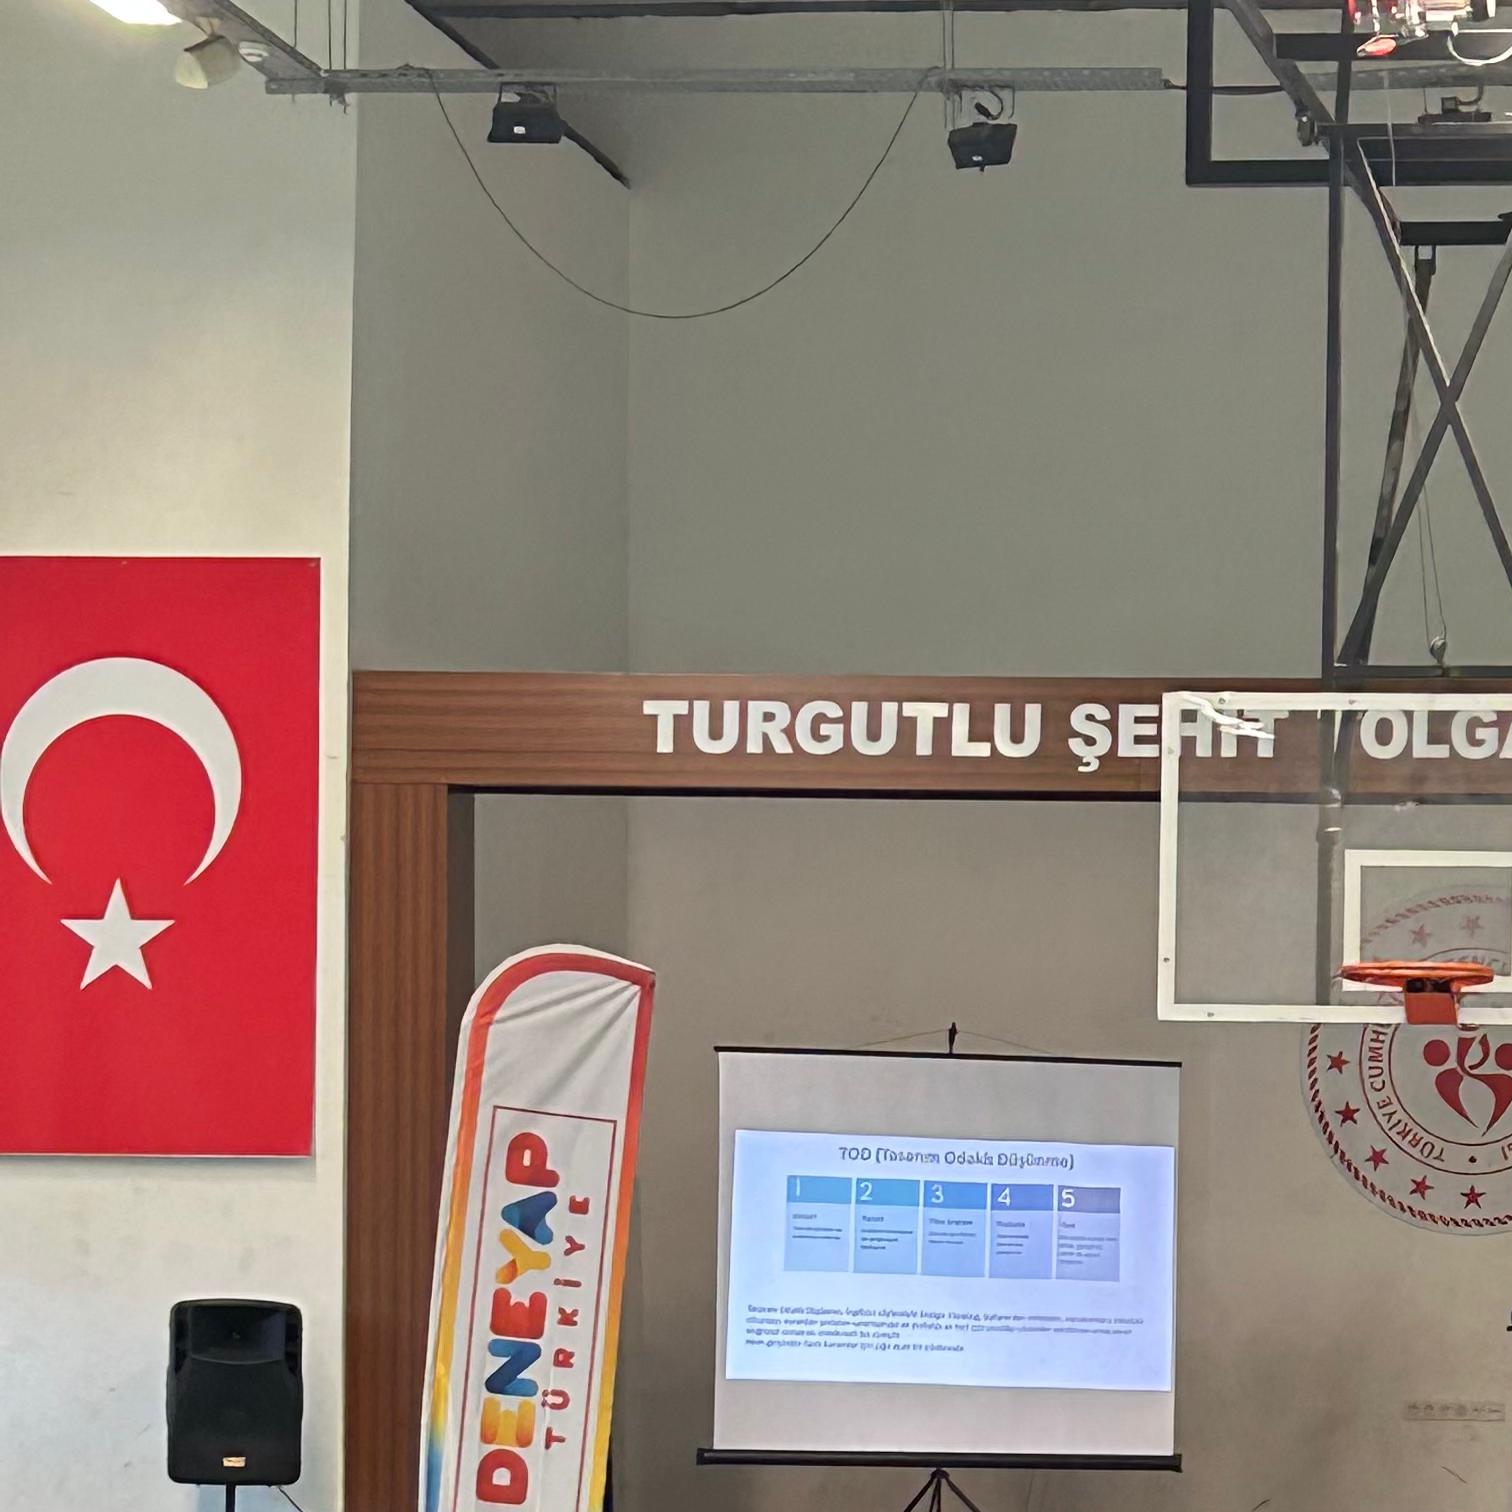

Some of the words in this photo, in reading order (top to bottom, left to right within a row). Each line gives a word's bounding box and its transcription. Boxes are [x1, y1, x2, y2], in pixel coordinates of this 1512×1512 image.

[642, 699, 1041, 758] TURGUTLU
[859, 1181, 873, 1201] 2
[930, 1184, 944, 1204] 3
[997, 1187, 1012, 1207] 4
[1060, 1188, 1076, 1208] 5
[475, 1131, 561, 1506] DENEYAP
[541, 1194, 591, 1451] TÜRKİYE
